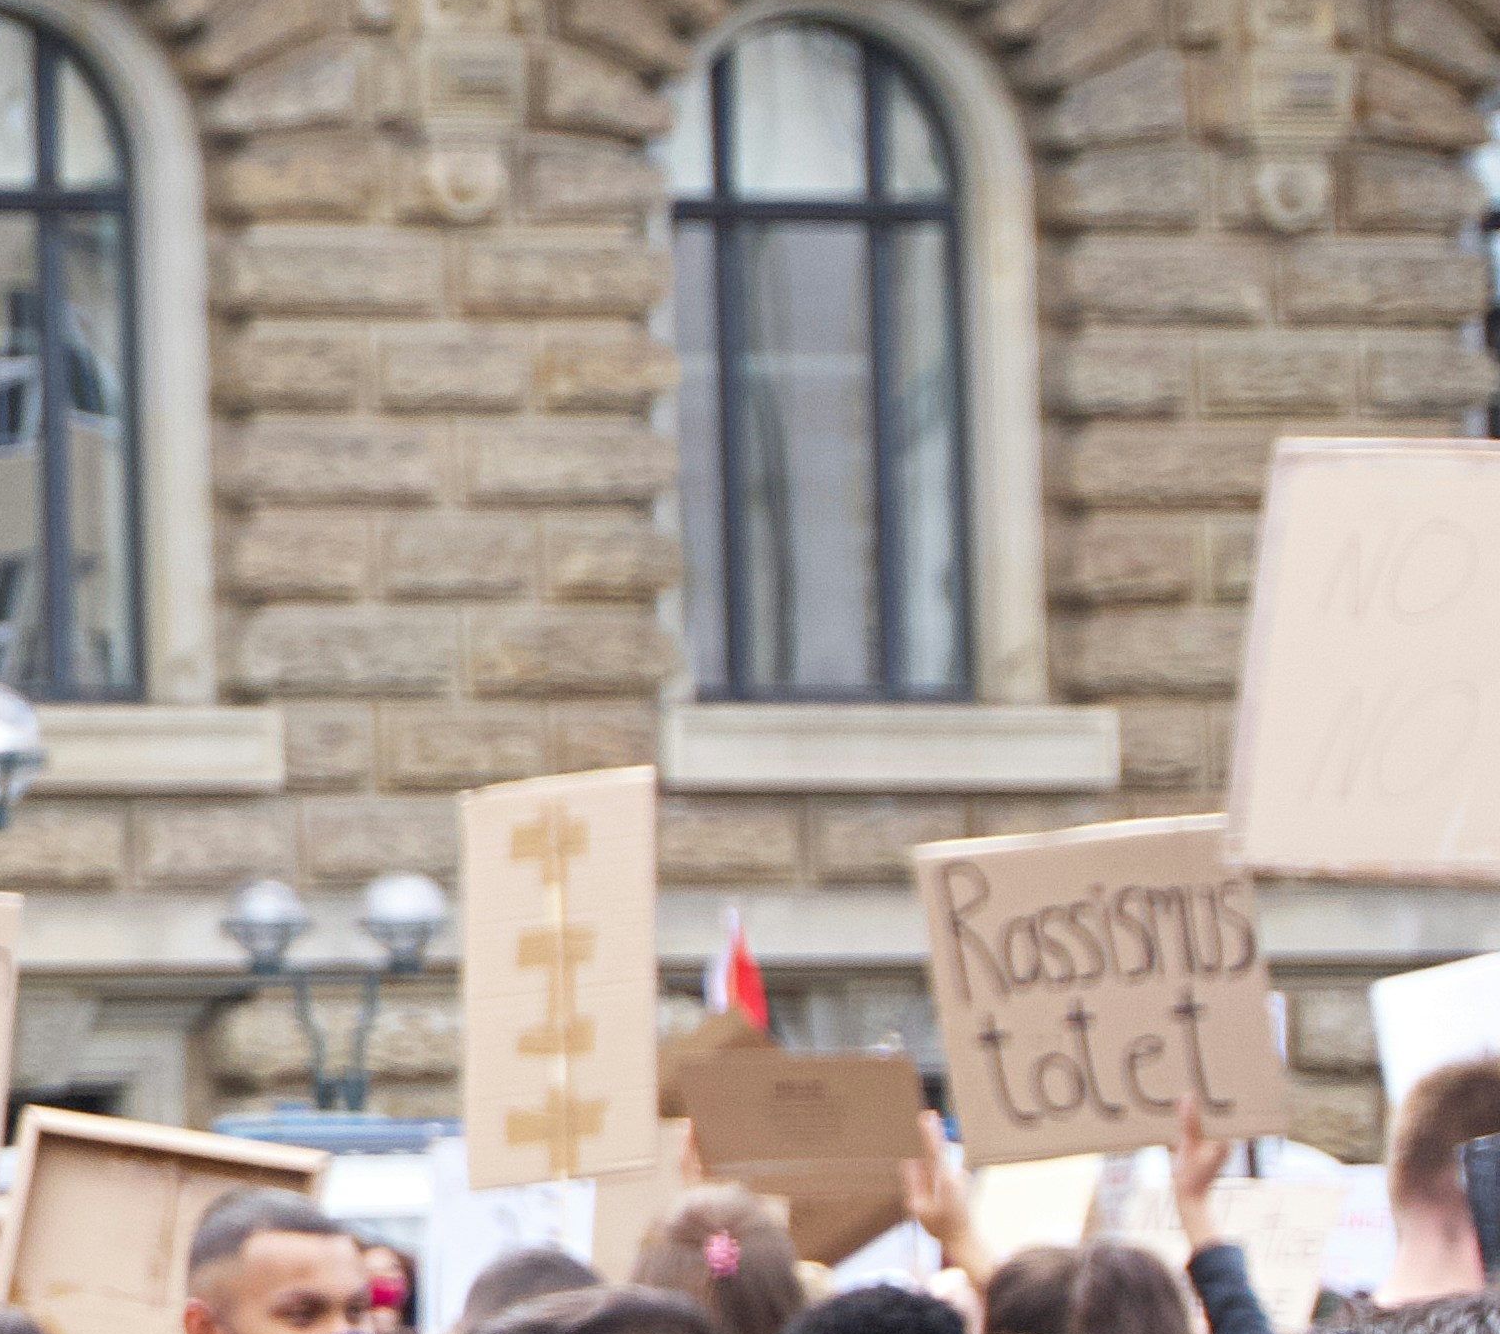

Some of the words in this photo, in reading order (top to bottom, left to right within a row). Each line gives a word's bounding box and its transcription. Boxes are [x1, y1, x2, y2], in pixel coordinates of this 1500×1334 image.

[1315, 514, 1482, 627] NO
[1298, 670, 1482, 807] NO
[937, 860, 1257, 1002] Rassismus
